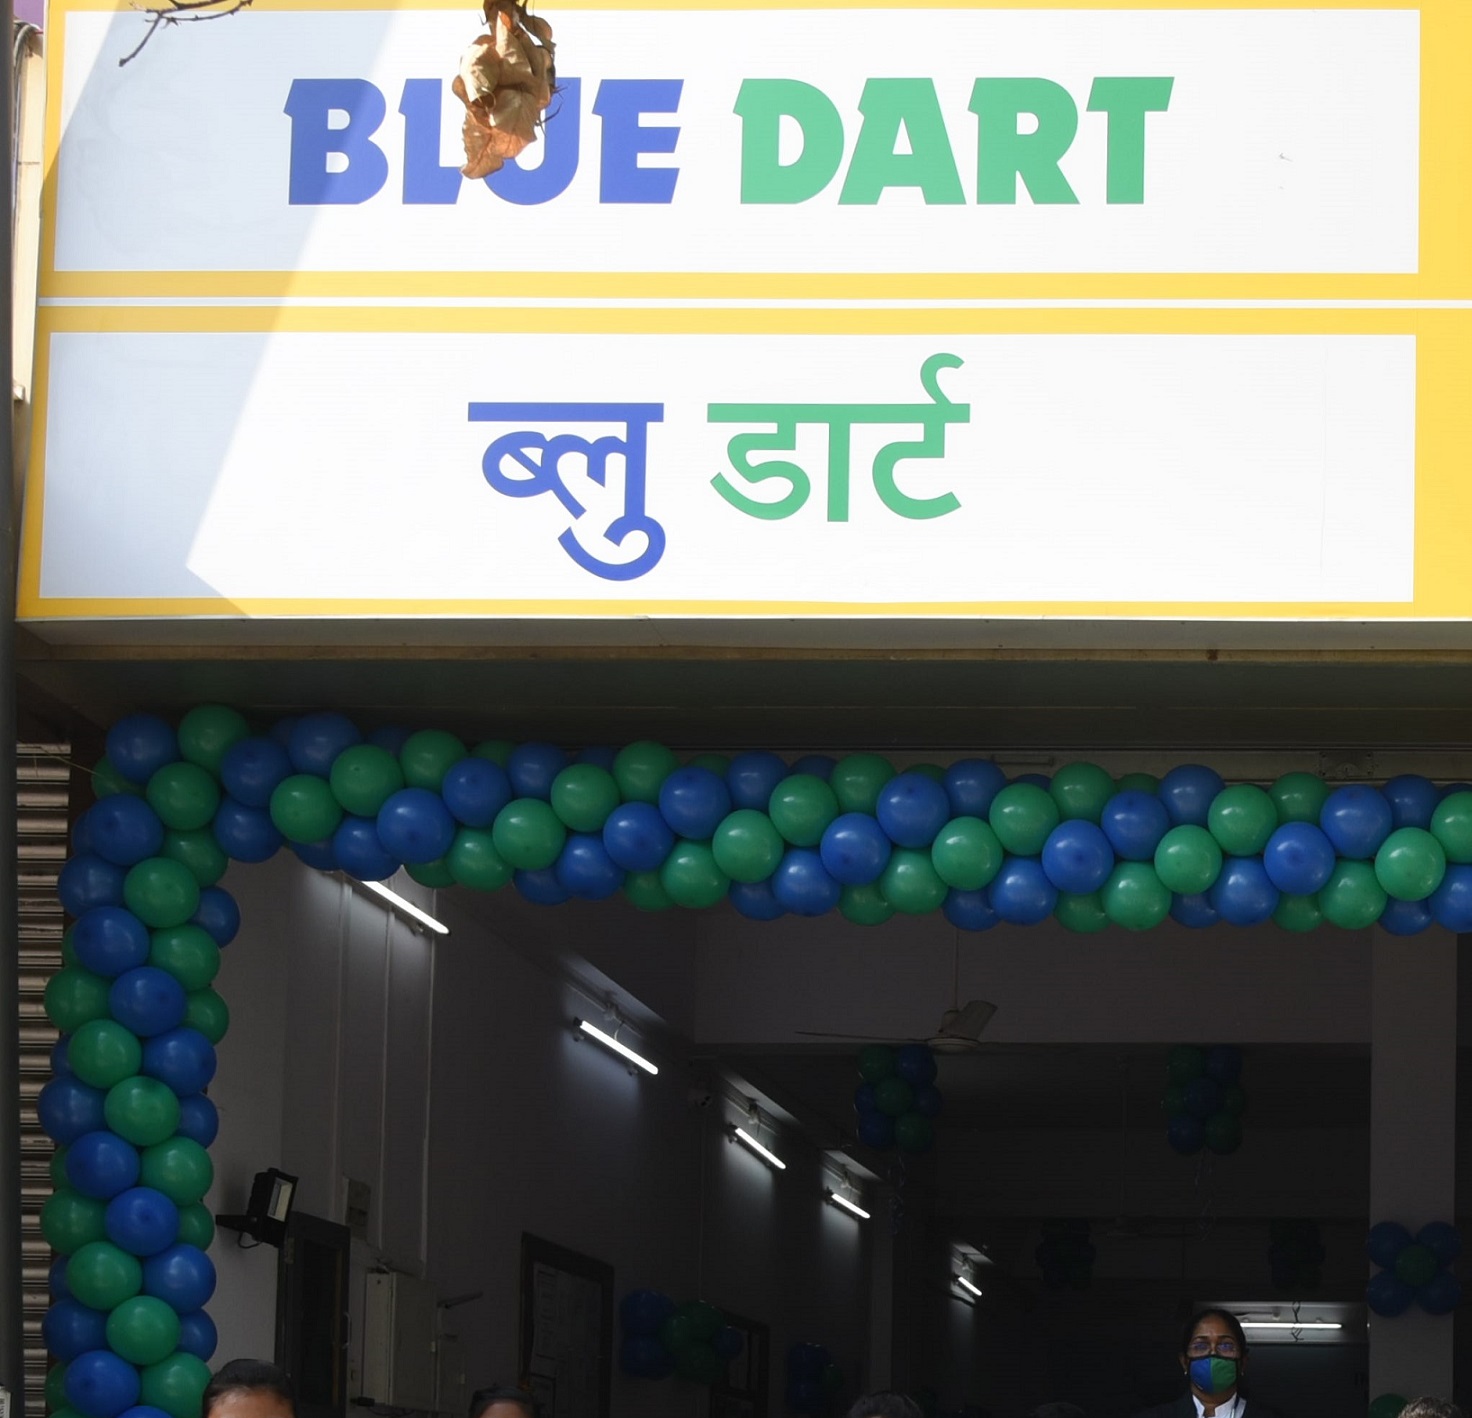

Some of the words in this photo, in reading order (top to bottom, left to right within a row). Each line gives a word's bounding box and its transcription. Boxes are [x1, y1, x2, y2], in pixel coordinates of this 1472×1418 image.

[283, 78, 684, 205] BLUE
[733, 77, 1175, 205] DART
[468, 401, 666, 582] ब्लु
[707, 352, 971, 522] डार्ट
